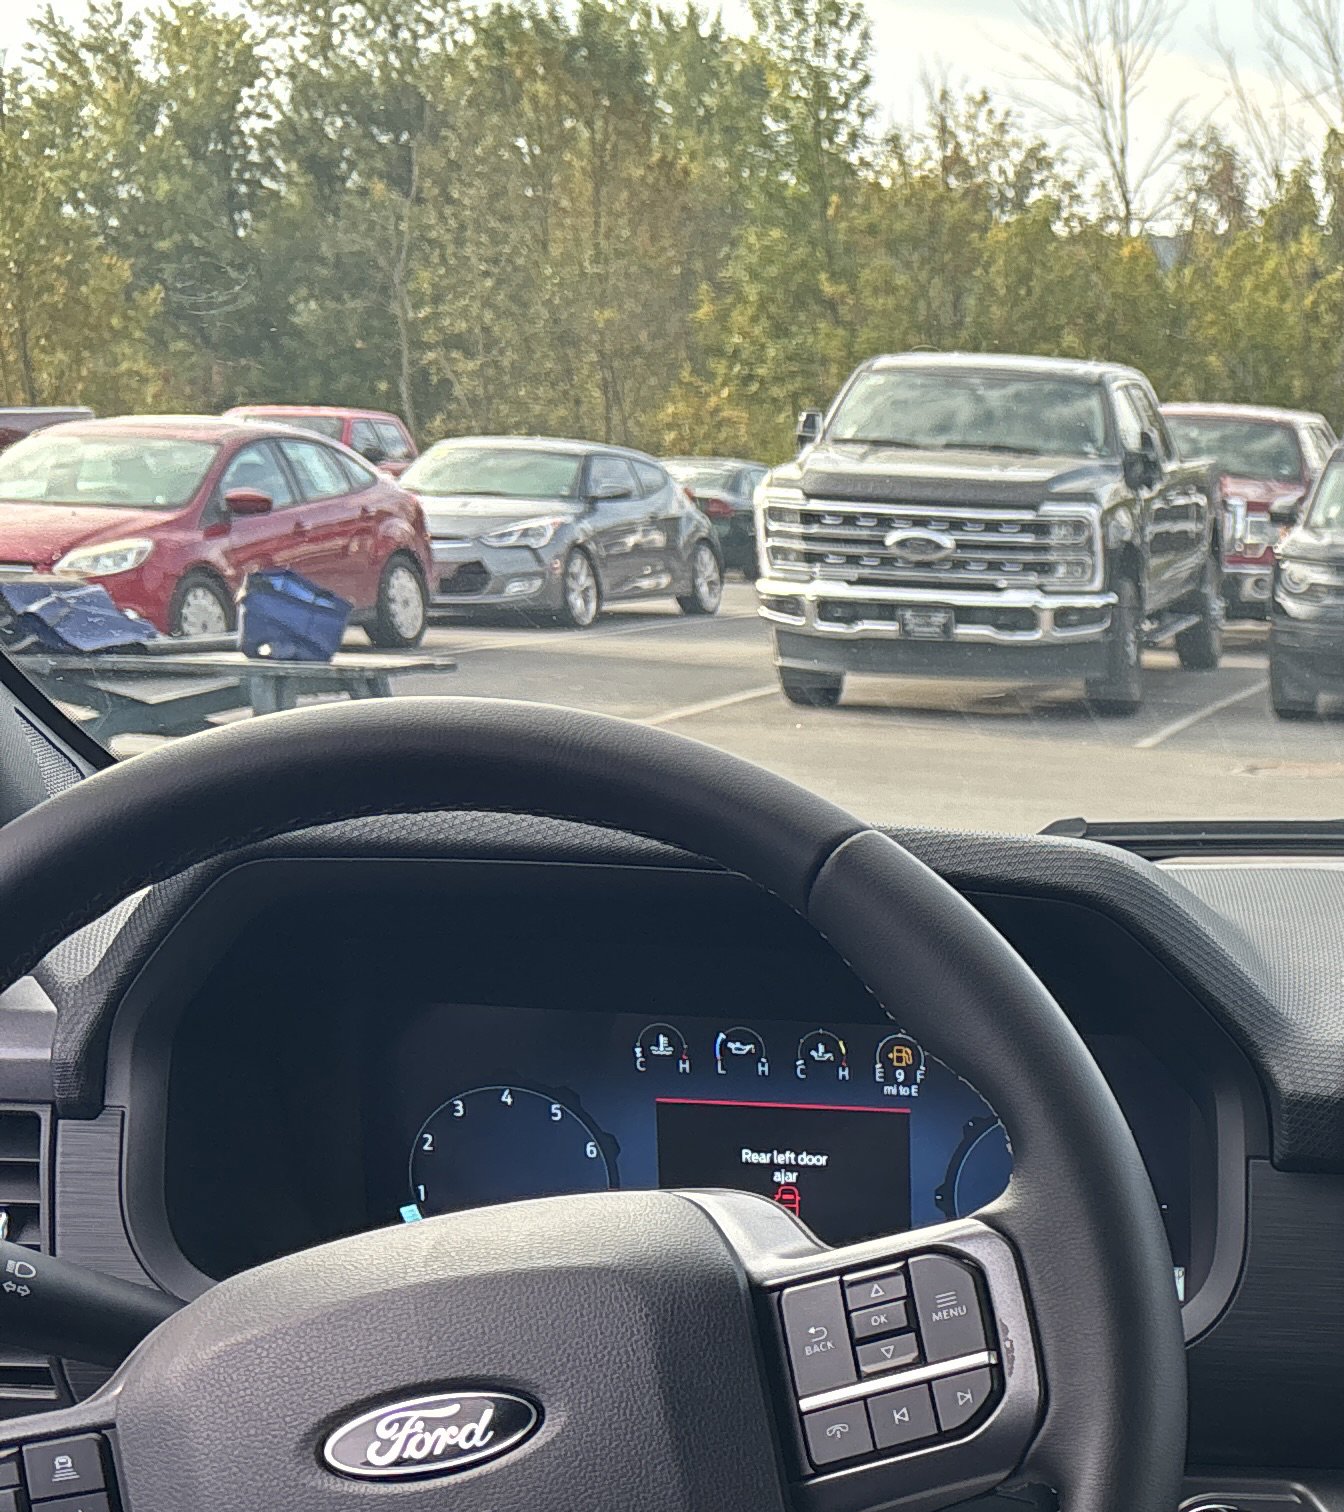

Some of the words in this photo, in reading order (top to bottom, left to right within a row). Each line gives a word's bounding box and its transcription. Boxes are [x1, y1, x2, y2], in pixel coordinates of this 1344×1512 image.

[636, 1059, 646, 1071] C
[679, 1060, 690, 1073] H
[717, 1062, 726, 1074] L
[758, 1063, 769, 1076] H
[796, 1066, 807, 1079] C
[839, 1067, 849, 1080] H
[875, 1069, 884, 1082] E
[896, 1070, 905, 1082] 9
[916, 1070, 925, 1083] F
[501, 1088, 513, 1106] 4
[453, 1100, 465, 1118] 3
[550, 1103, 562, 1121] 5
[423, 1133, 434, 1152] 2
[585, 1140, 597, 1158] 6
[741, 1149, 771, 1164] Rear
[773, 1150, 796, 1165] left
[798, 1151, 828, 1166] door
[773, 1170, 798, 1185] ajar
[417, 1184, 426, 1201] 1
[871, 1314, 888, 1326] OK
[932, 1306, 967, 1322] MENU
[805, 1340, 835, 1356] BACK
[367, 1403, 495, 1466] Ford
